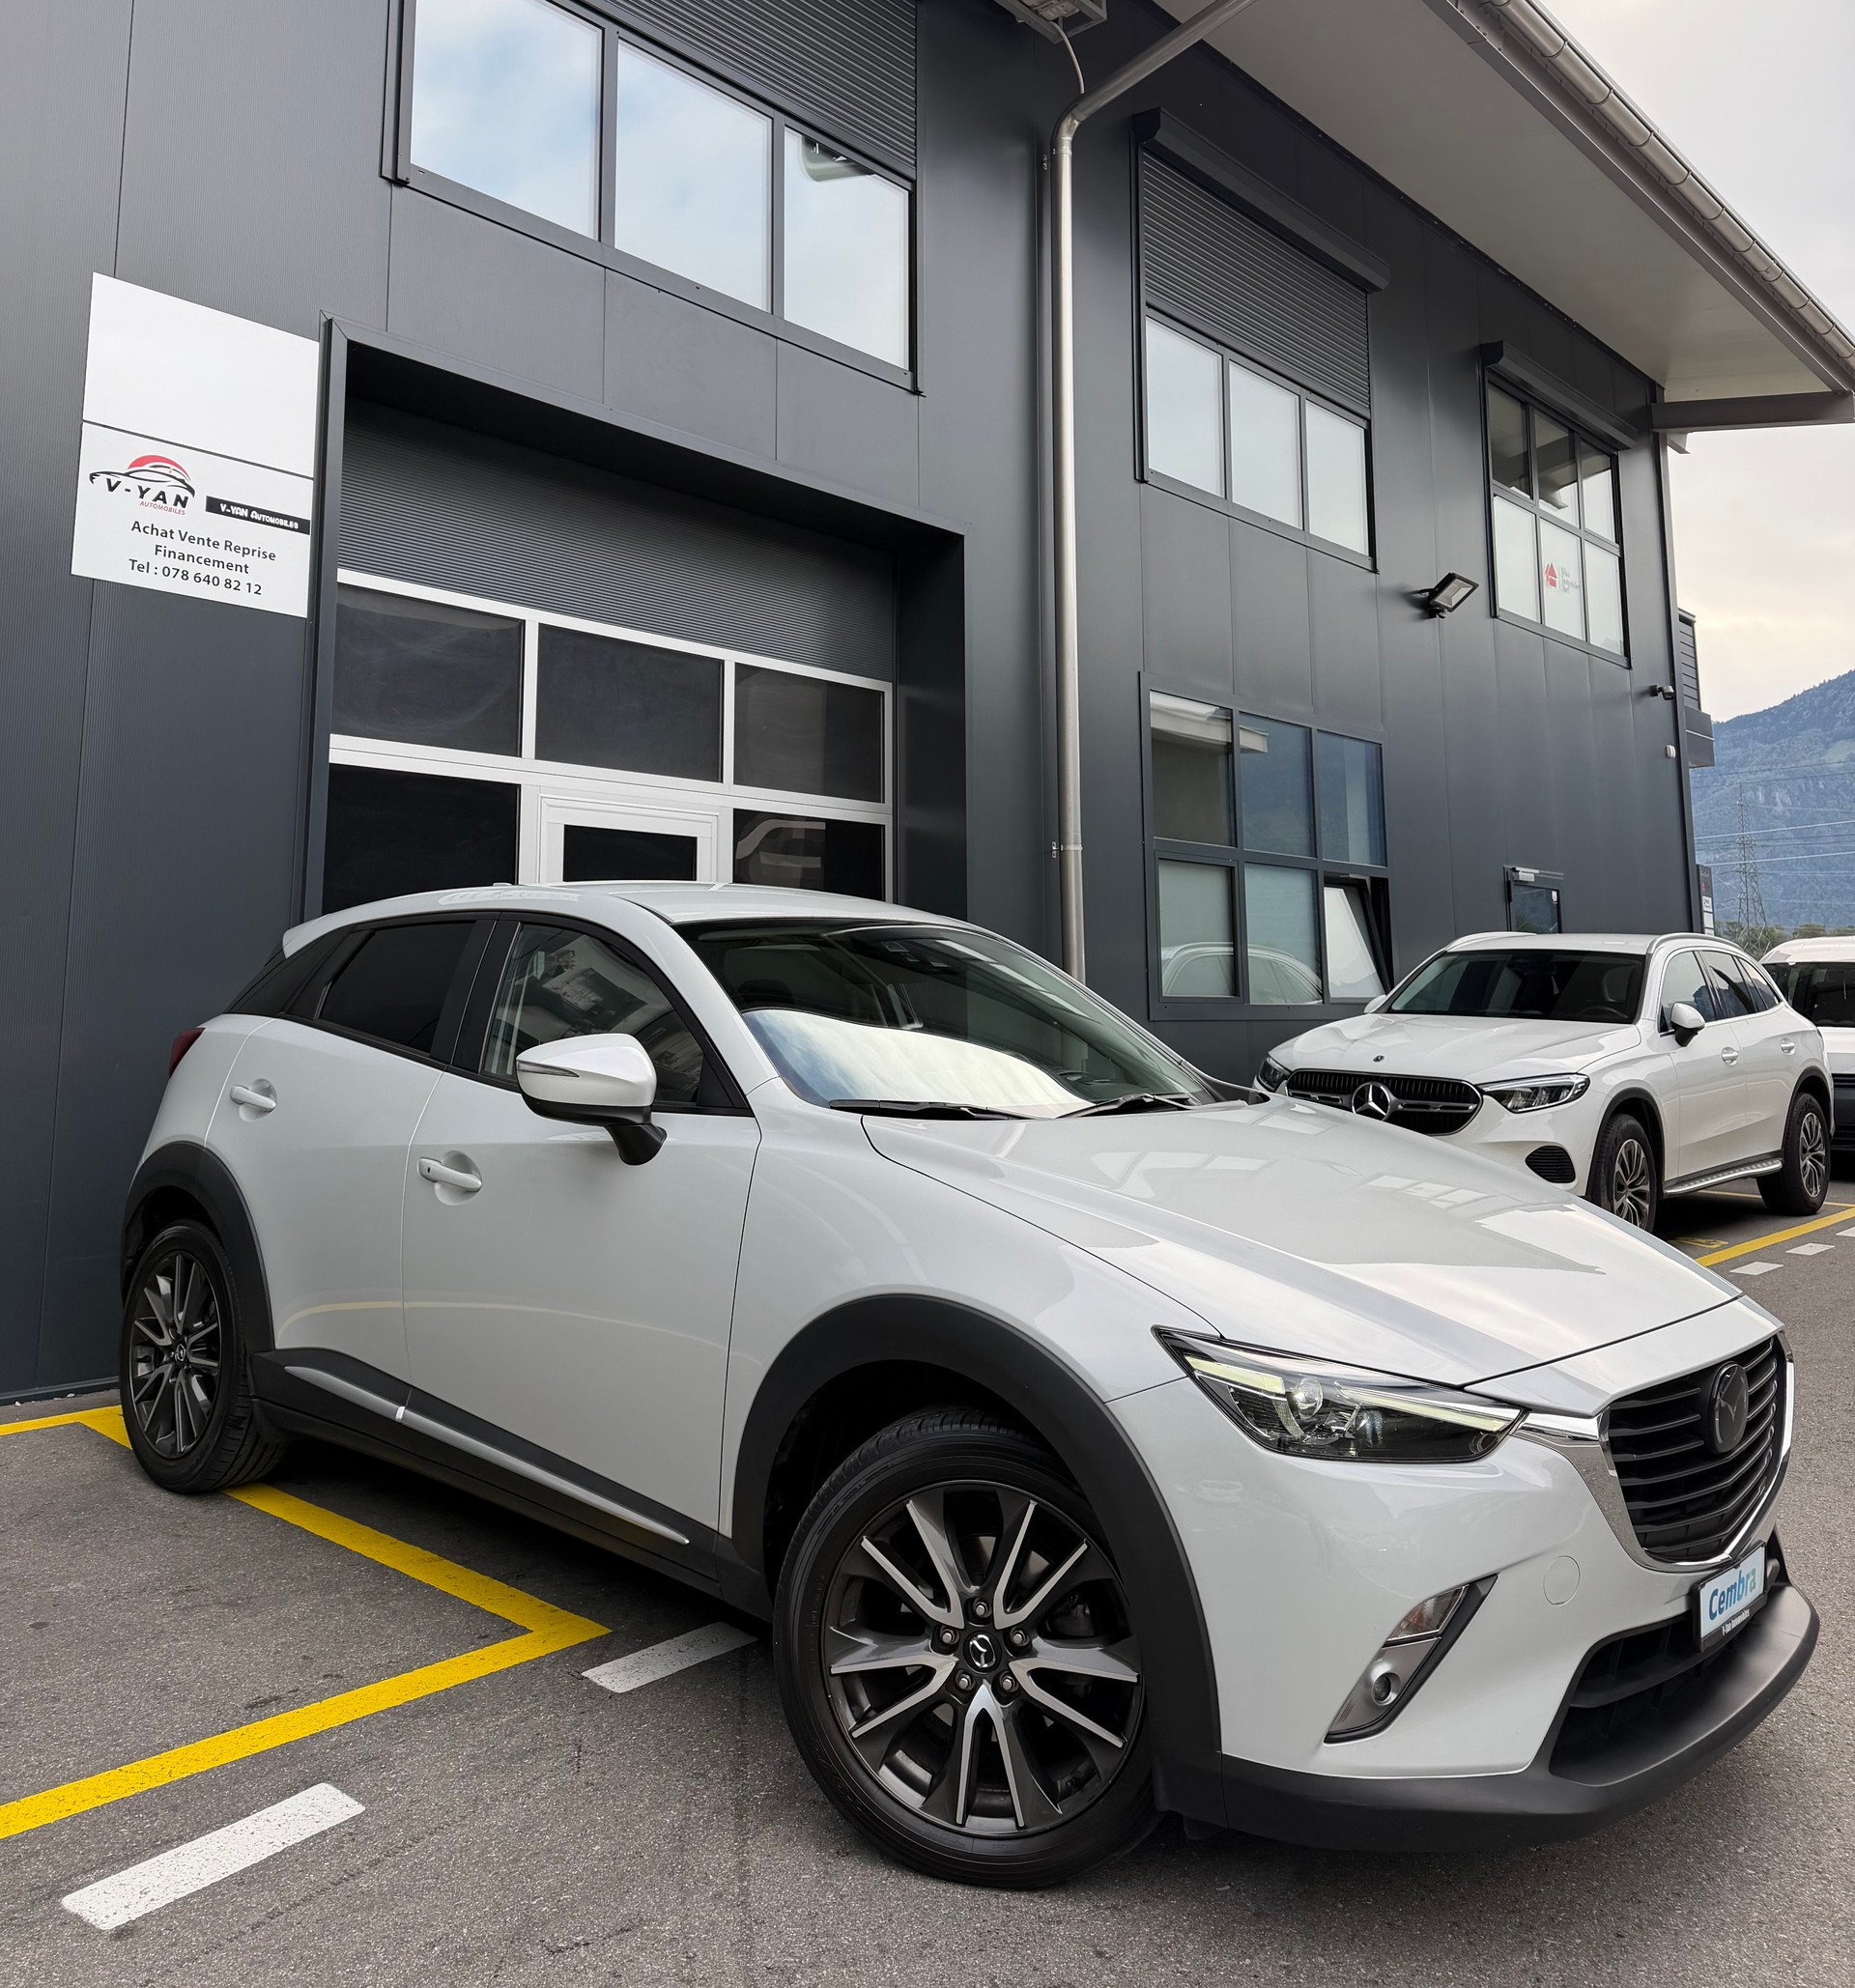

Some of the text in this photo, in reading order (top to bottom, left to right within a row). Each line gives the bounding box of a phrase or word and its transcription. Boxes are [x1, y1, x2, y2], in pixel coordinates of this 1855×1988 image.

[106, 477, 189, 509] V-YAN
[139, 500, 186, 516] AUTOMOBILES
[219, 503, 249, 518] V-YAN
[130, 521, 277, 561] Achat Vente Reprise
[155, 544, 250, 575] Financement
[161, 565, 189, 582] 078
[193, 572, 220, 587] 640
[224, 578, 242, 592] 82
[245, 582, 263, 596] 12
[1708, 1567, 1756, 1621] Cembra
